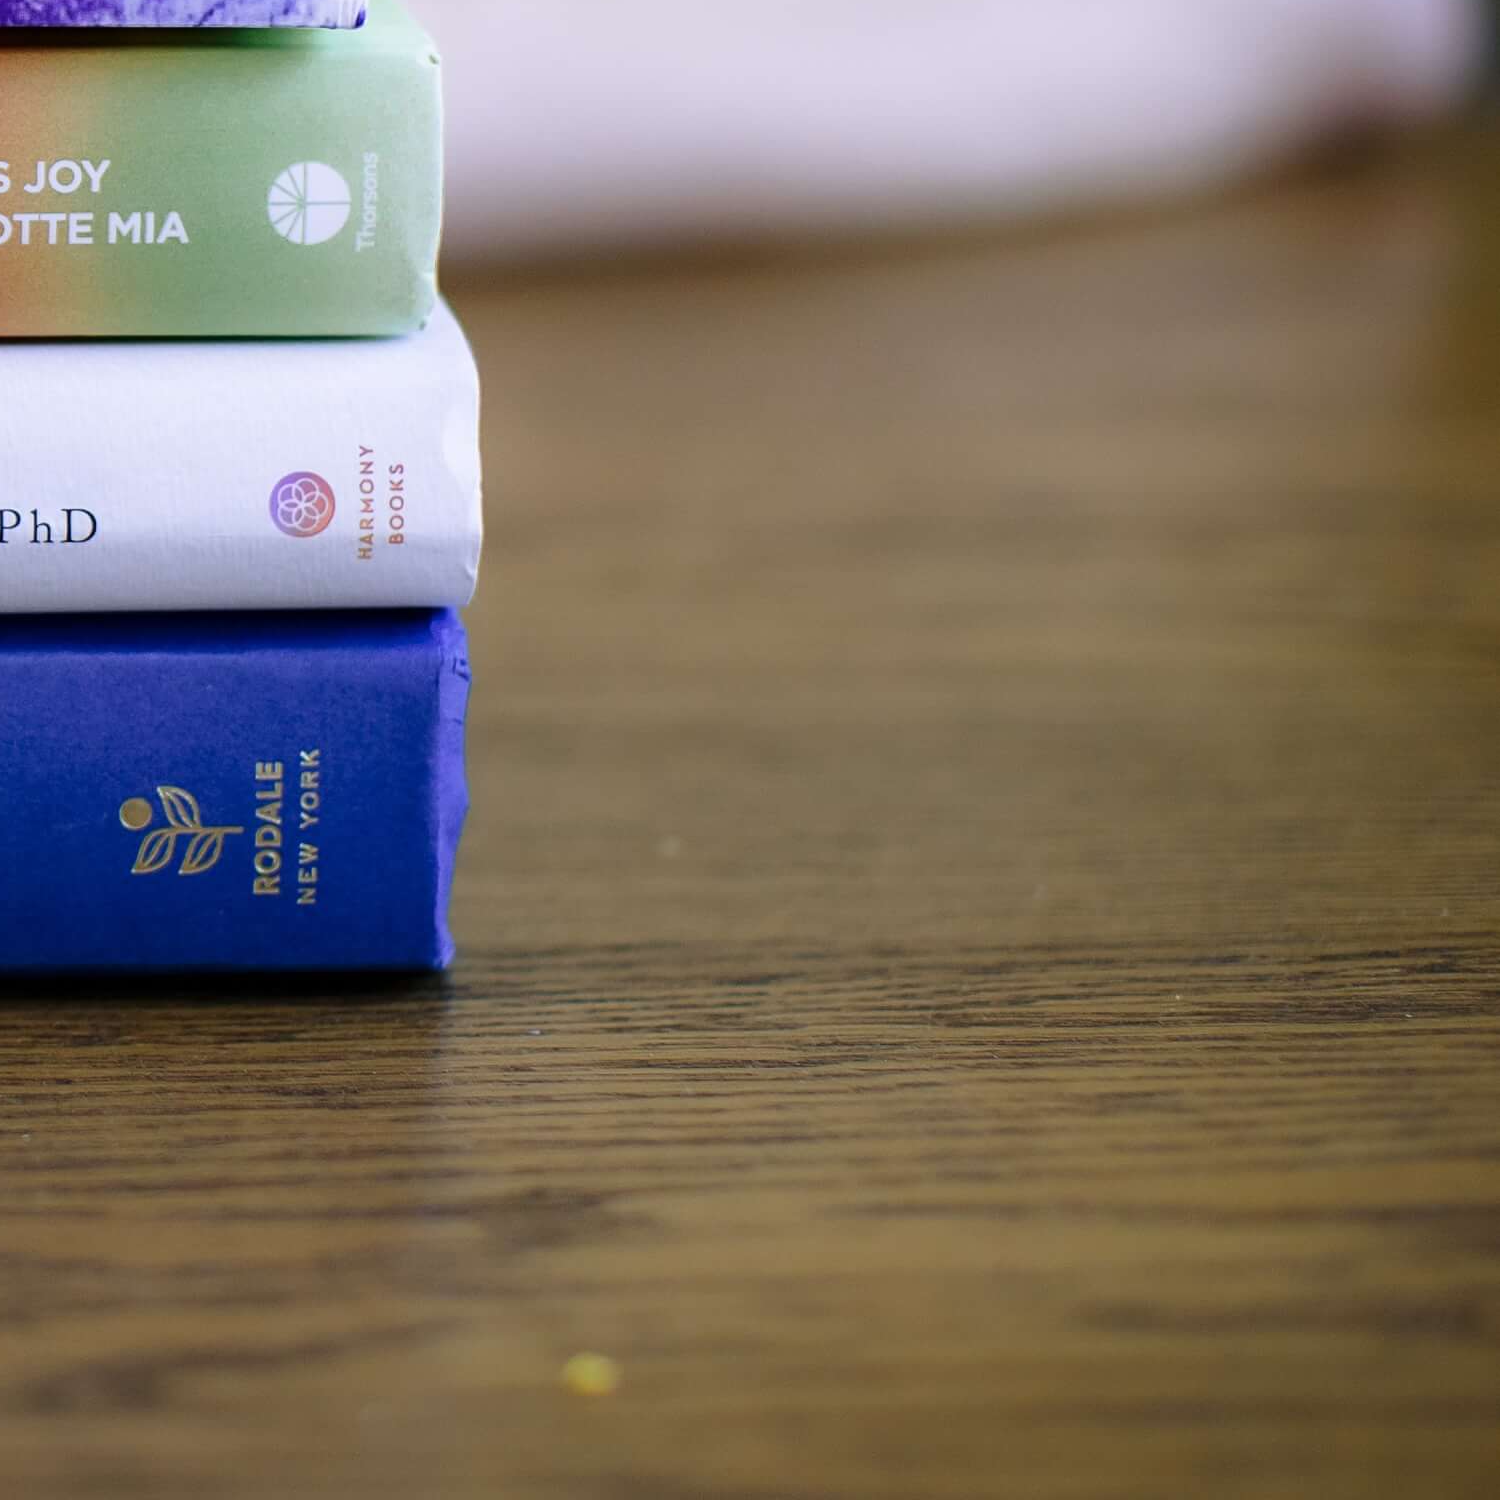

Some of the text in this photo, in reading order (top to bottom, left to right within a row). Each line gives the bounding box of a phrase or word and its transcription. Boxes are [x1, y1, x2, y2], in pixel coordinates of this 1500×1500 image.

[23, 159, 111, 194] JOY
[108, 211, 189, 244] MIA
[353, 148, 380, 255] Thorsons
[357, 442, 376, 562] HARMONY
[388, 460, 406, 547] BOOKS
[253, 761, 283, 895] RODALE
[296, 749, 320, 904] NEW YORK
